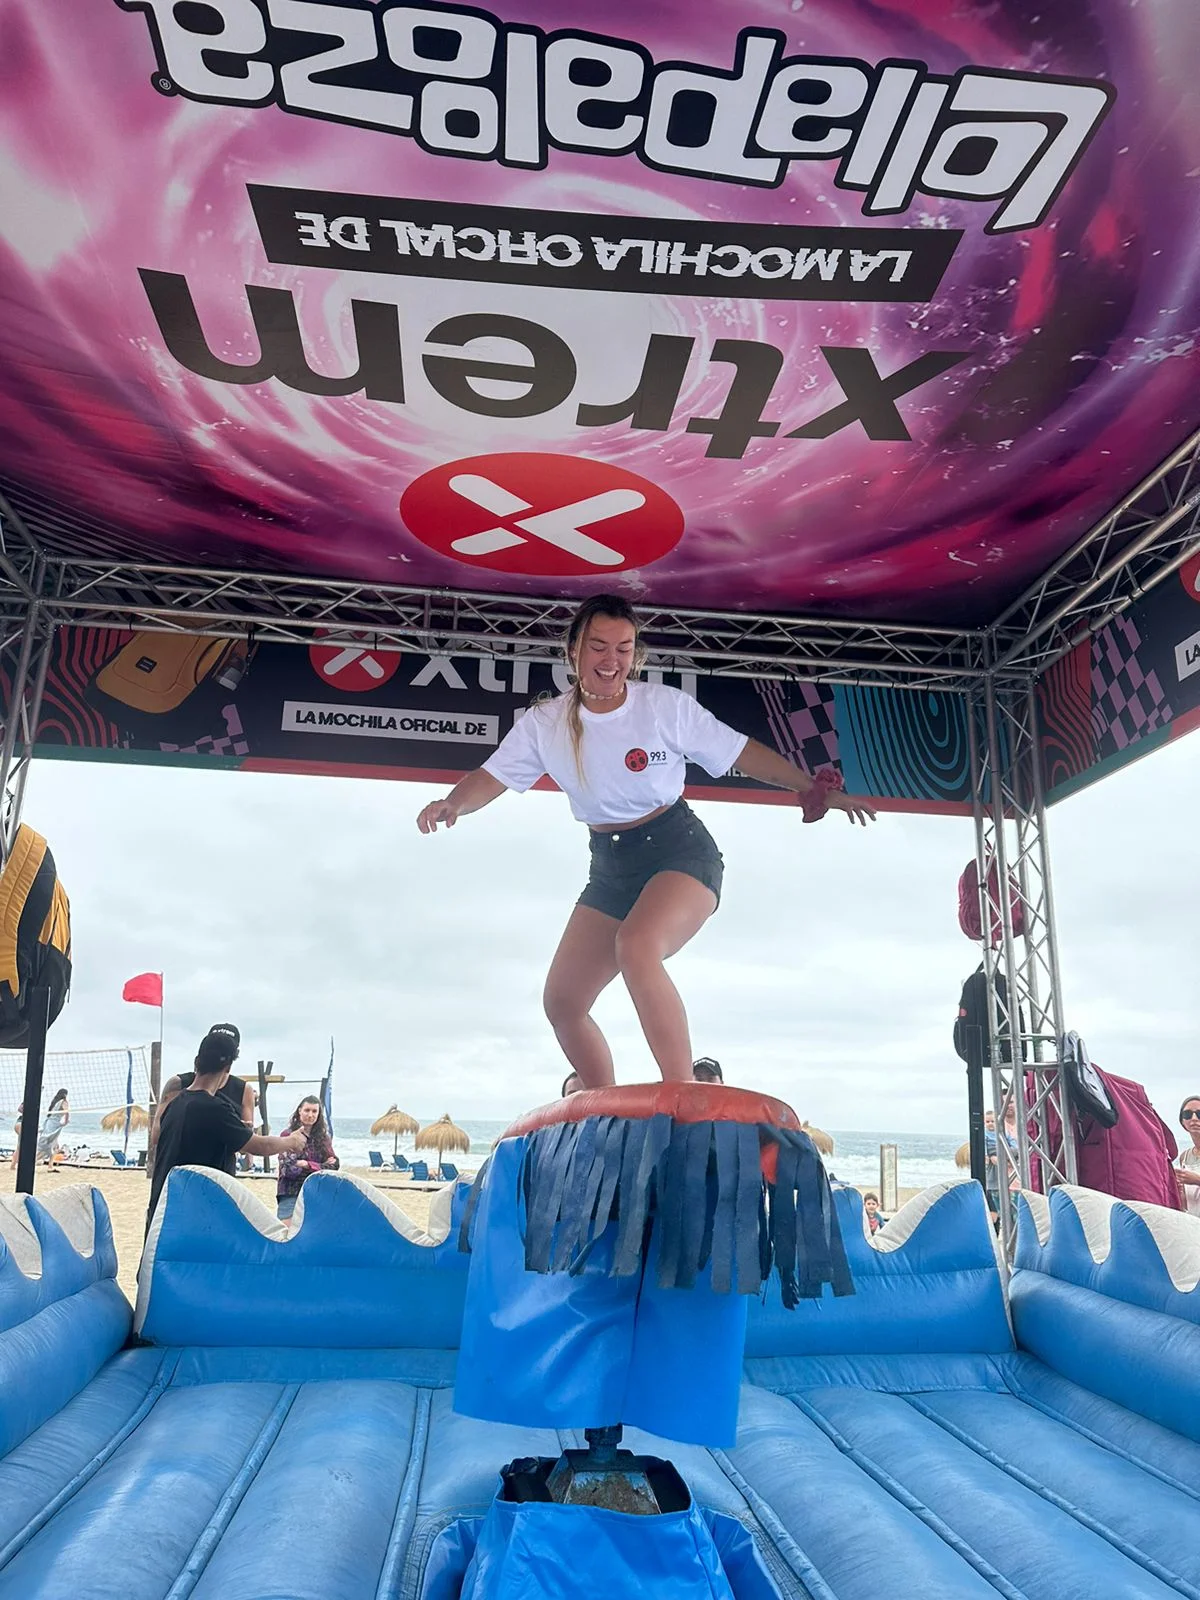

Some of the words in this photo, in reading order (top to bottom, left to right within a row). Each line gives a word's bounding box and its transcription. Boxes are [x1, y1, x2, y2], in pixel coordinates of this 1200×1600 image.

[125, 0, 1108, 230] Lollapalooza
[293, 210, 373, 252] DE
[379, 219, 584, 267] OFICIAL
[591, 237, 842, 281] MOCHILA
[850, 250, 912, 282] LA
[137, 267, 977, 459] xtrem
[295, 710, 316, 725] LA
[318, 711, 397, 730] MOCHILA
[400, 717, 461, 735] OFICIAL
[464, 722, 487, 736] DE
